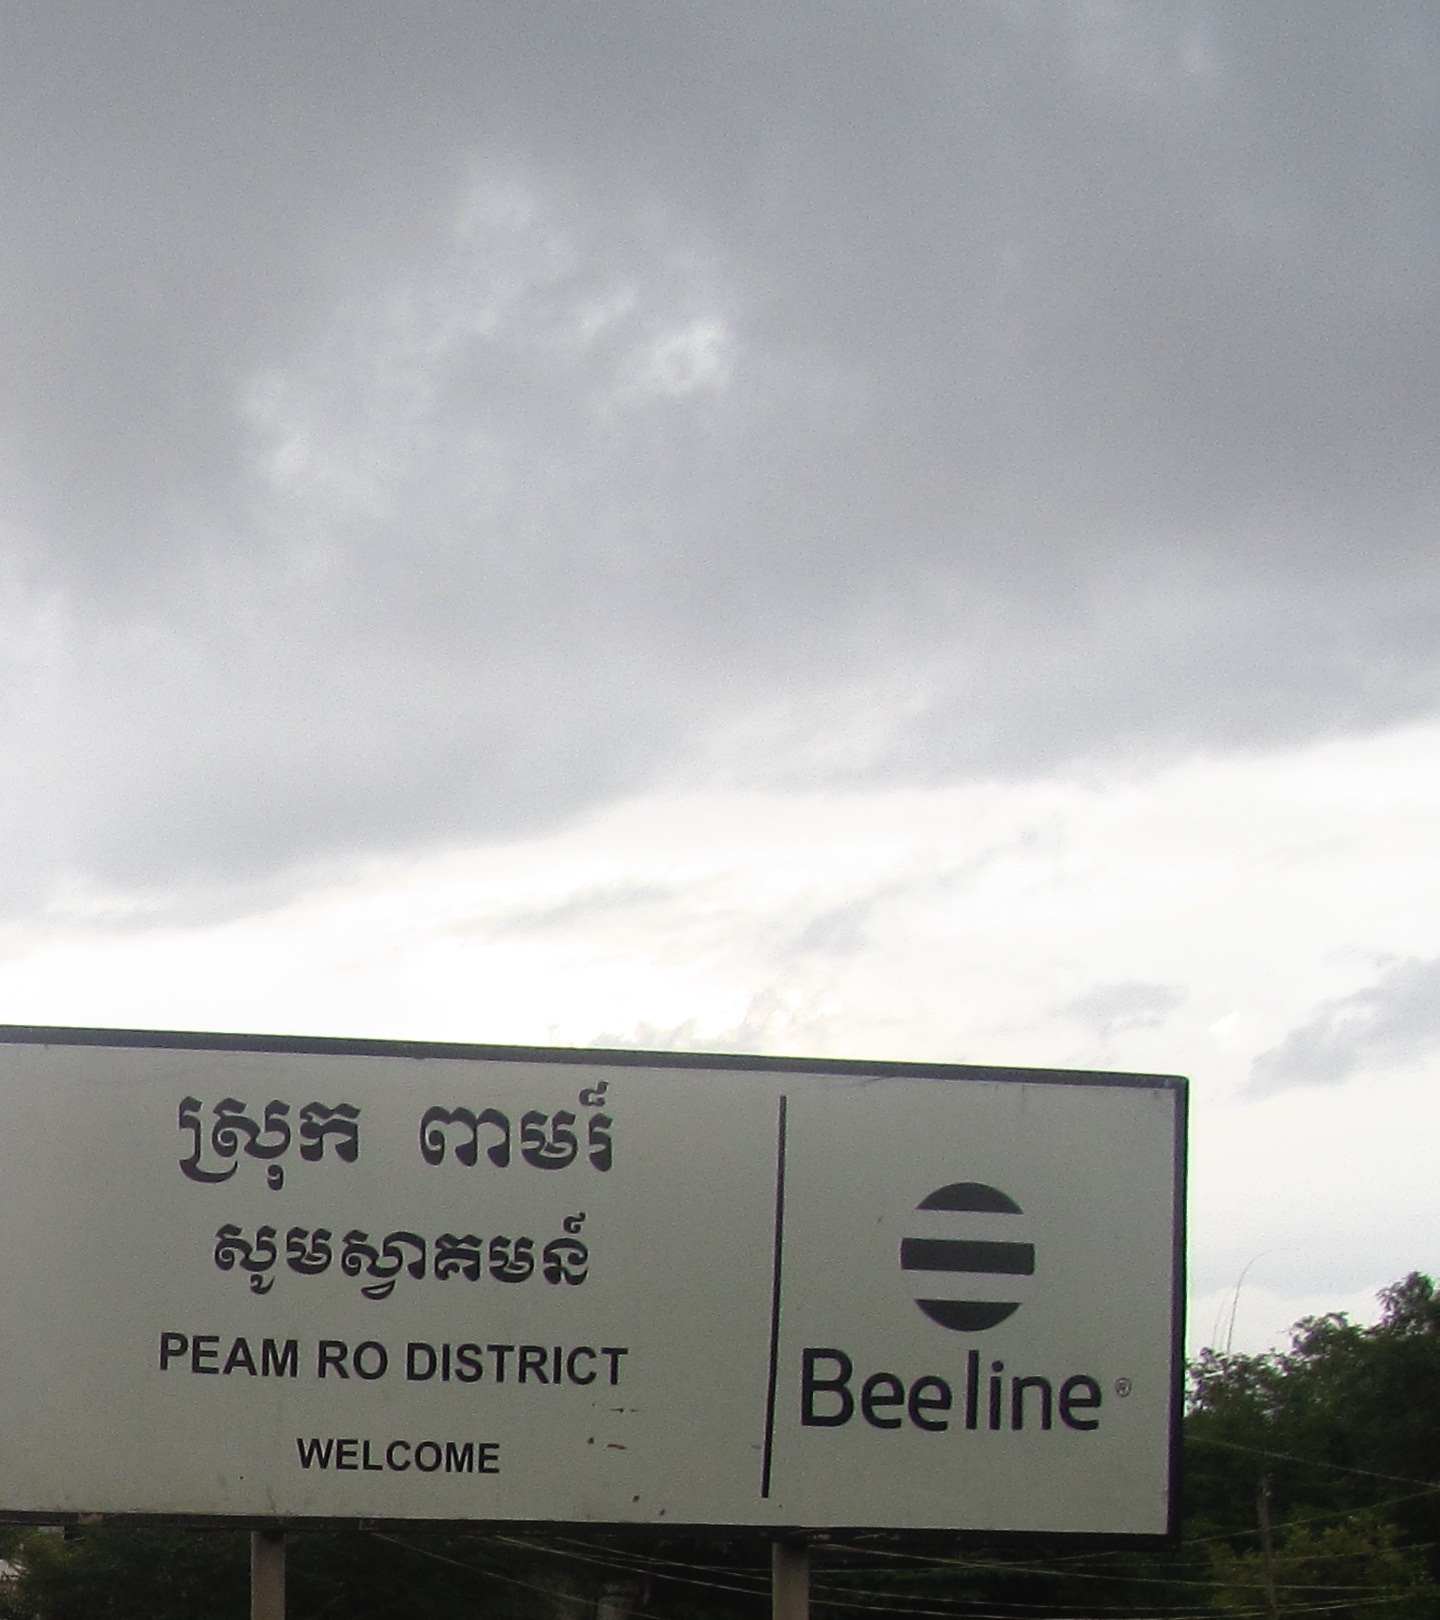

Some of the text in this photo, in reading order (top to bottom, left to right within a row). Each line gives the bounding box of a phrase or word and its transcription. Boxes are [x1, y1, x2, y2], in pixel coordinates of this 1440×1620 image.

[178, 1095, 362, 1192] ស្រុក
[213, 1211, 590, 1301] សូមស្វាគមន៍
[159, 1331, 630, 1387] PEAM RO DISTRICT
[799, 1346, 1106, 1434] Beeline
[295, 1437, 502, 1475] WELCOME
